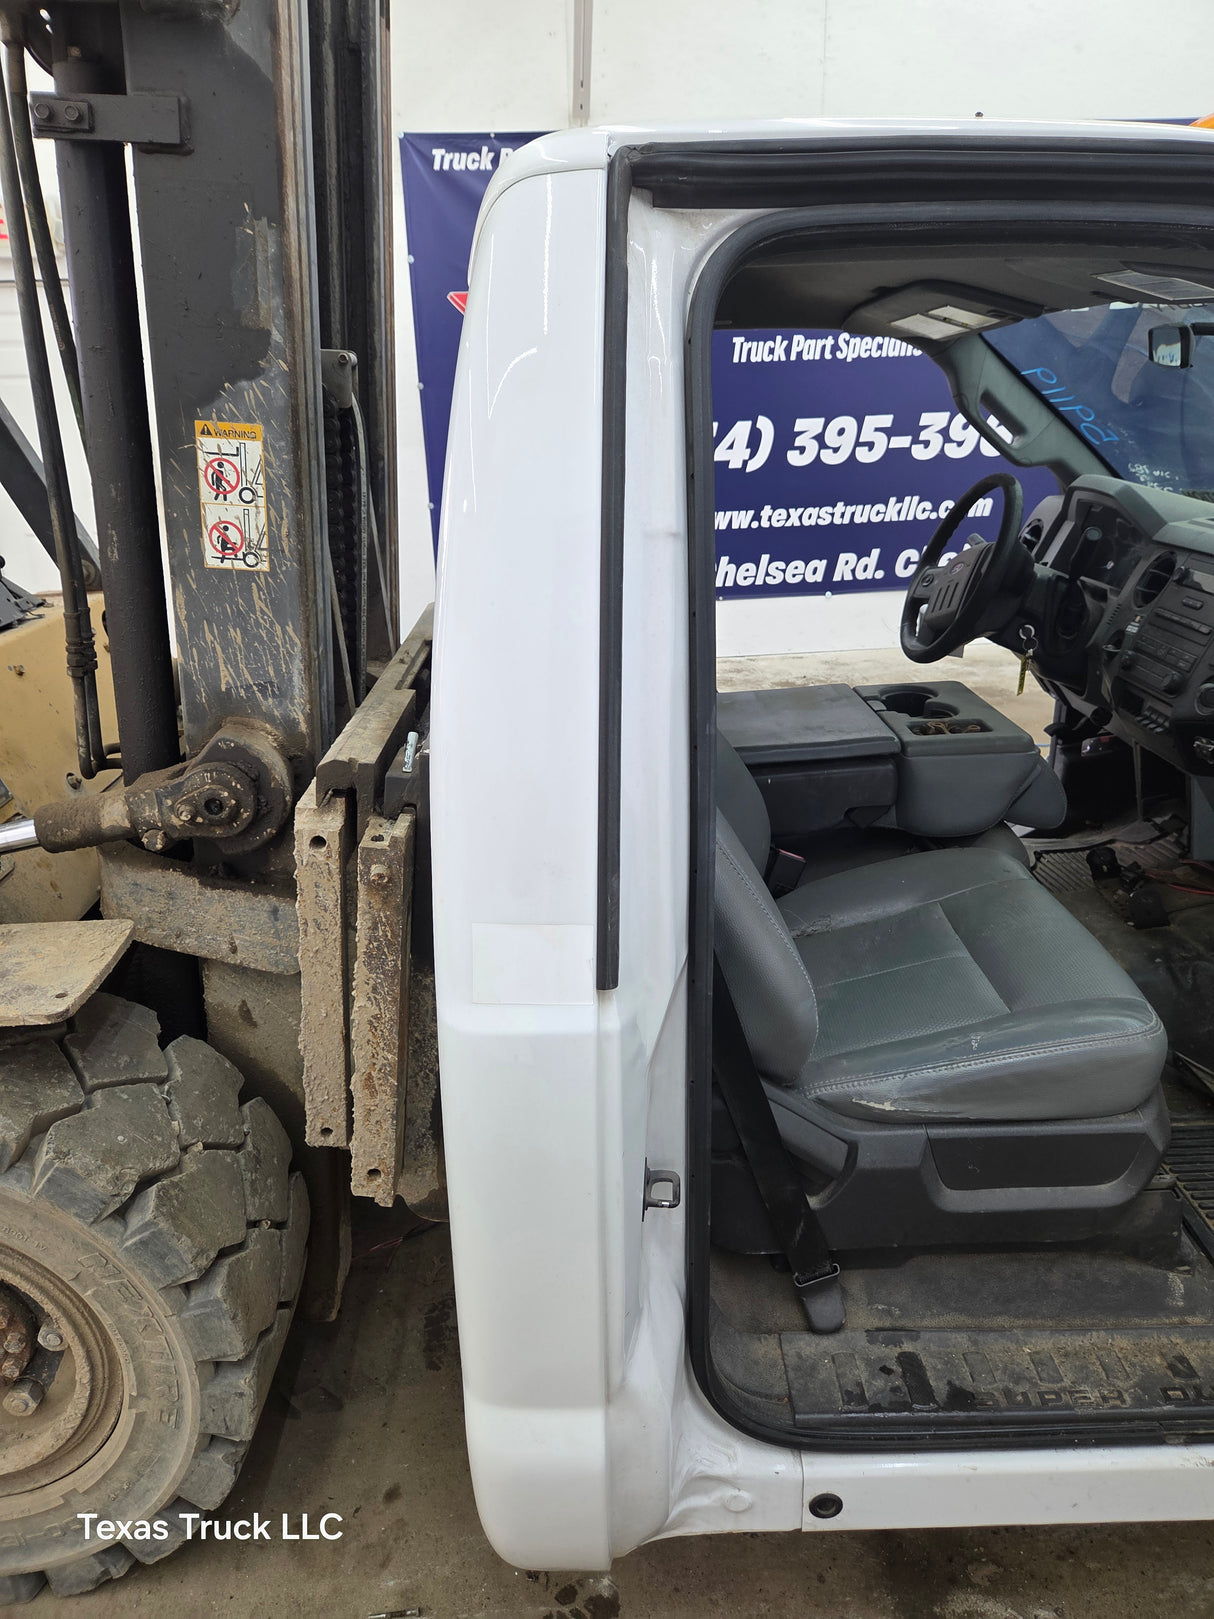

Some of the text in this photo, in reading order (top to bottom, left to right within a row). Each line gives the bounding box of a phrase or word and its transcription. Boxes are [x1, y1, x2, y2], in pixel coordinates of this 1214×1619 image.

[432, 146, 495, 171] Truck
[732, 335, 787, 363] Truck
[790, 334, 835, 361] Part
[213, 428, 257, 440] WARNING
[713, 415, 775, 473] 4)
[714, 553, 827, 588] helsea
[832, 548, 885, 582] Rd.
